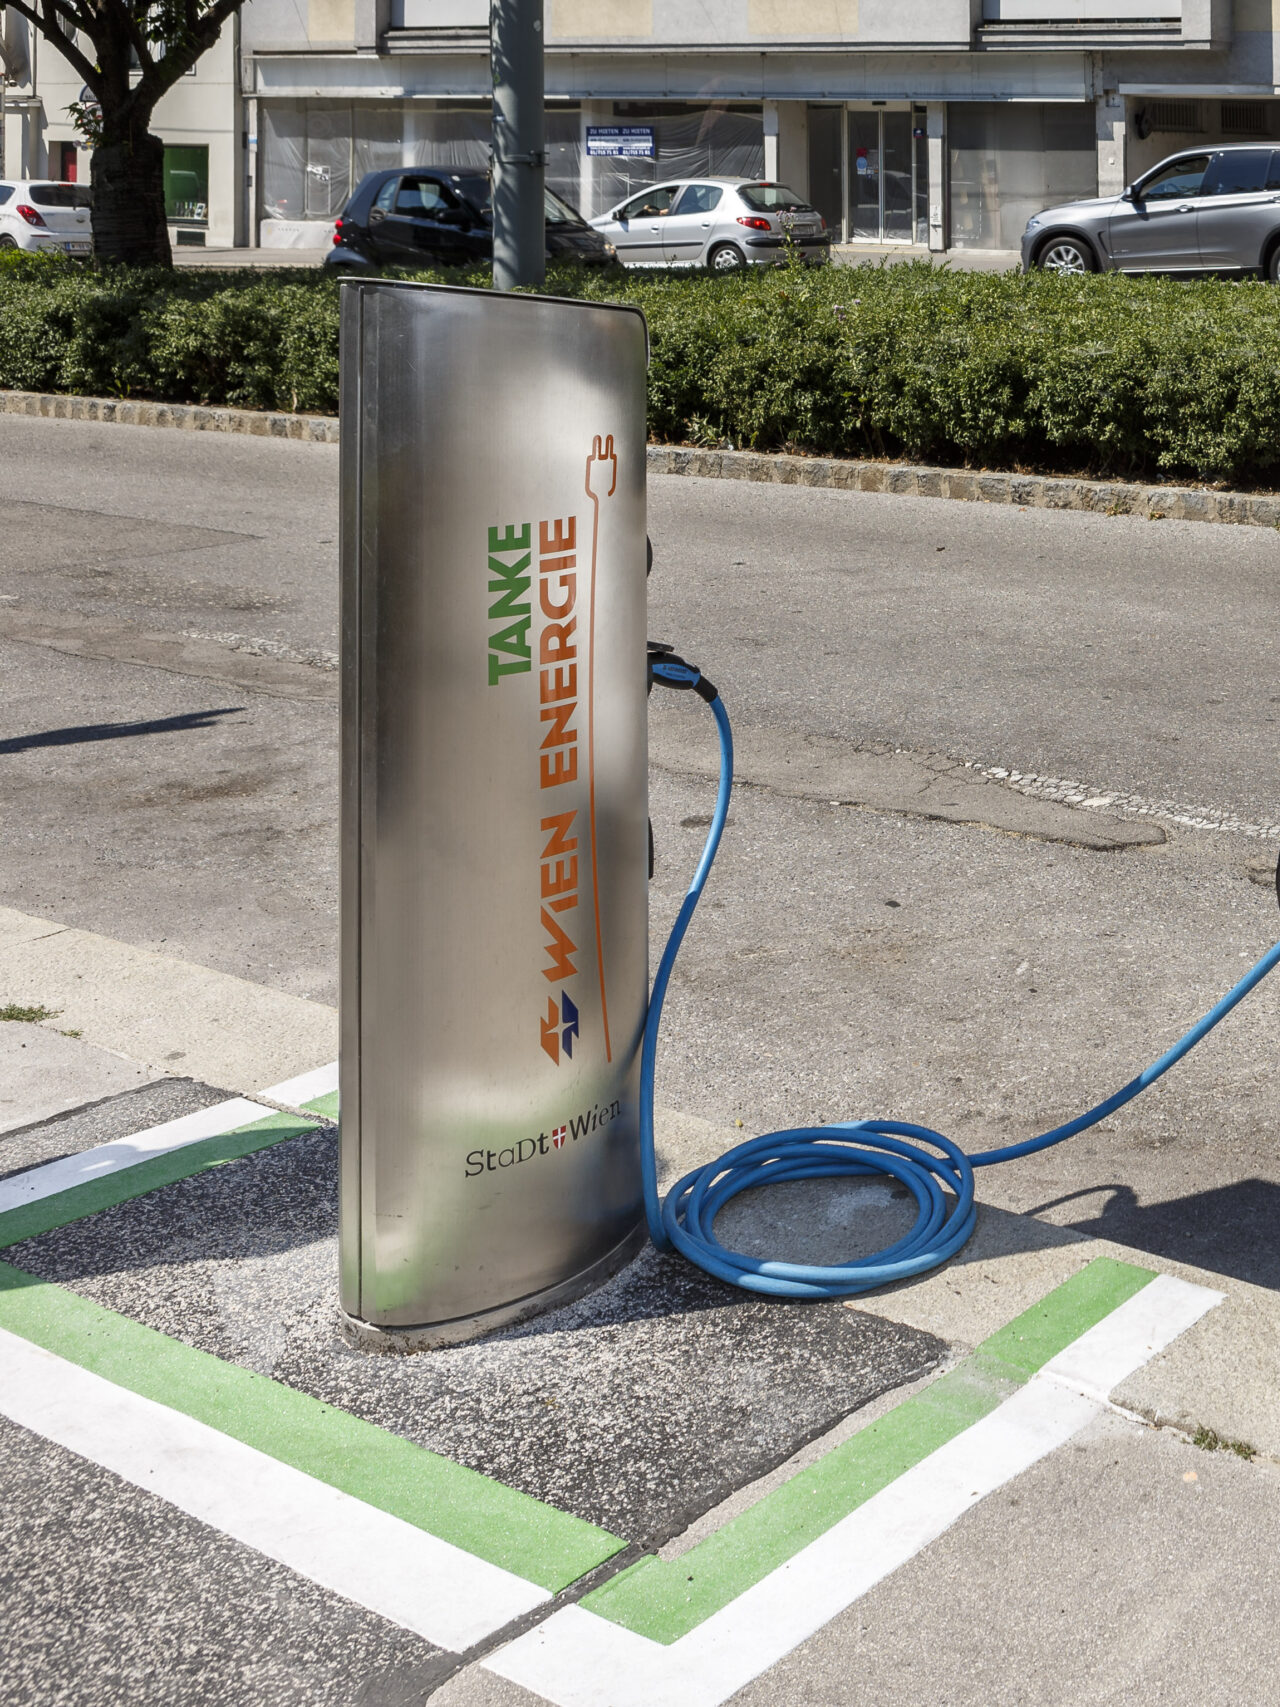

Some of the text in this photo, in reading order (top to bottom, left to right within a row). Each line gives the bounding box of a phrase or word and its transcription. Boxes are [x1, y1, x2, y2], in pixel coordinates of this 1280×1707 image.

[488, 523, 531, 686] TANKE
[539, 516, 578, 982] WIEN ENERGIE
[569, 1100, 622, 1141] Wien
